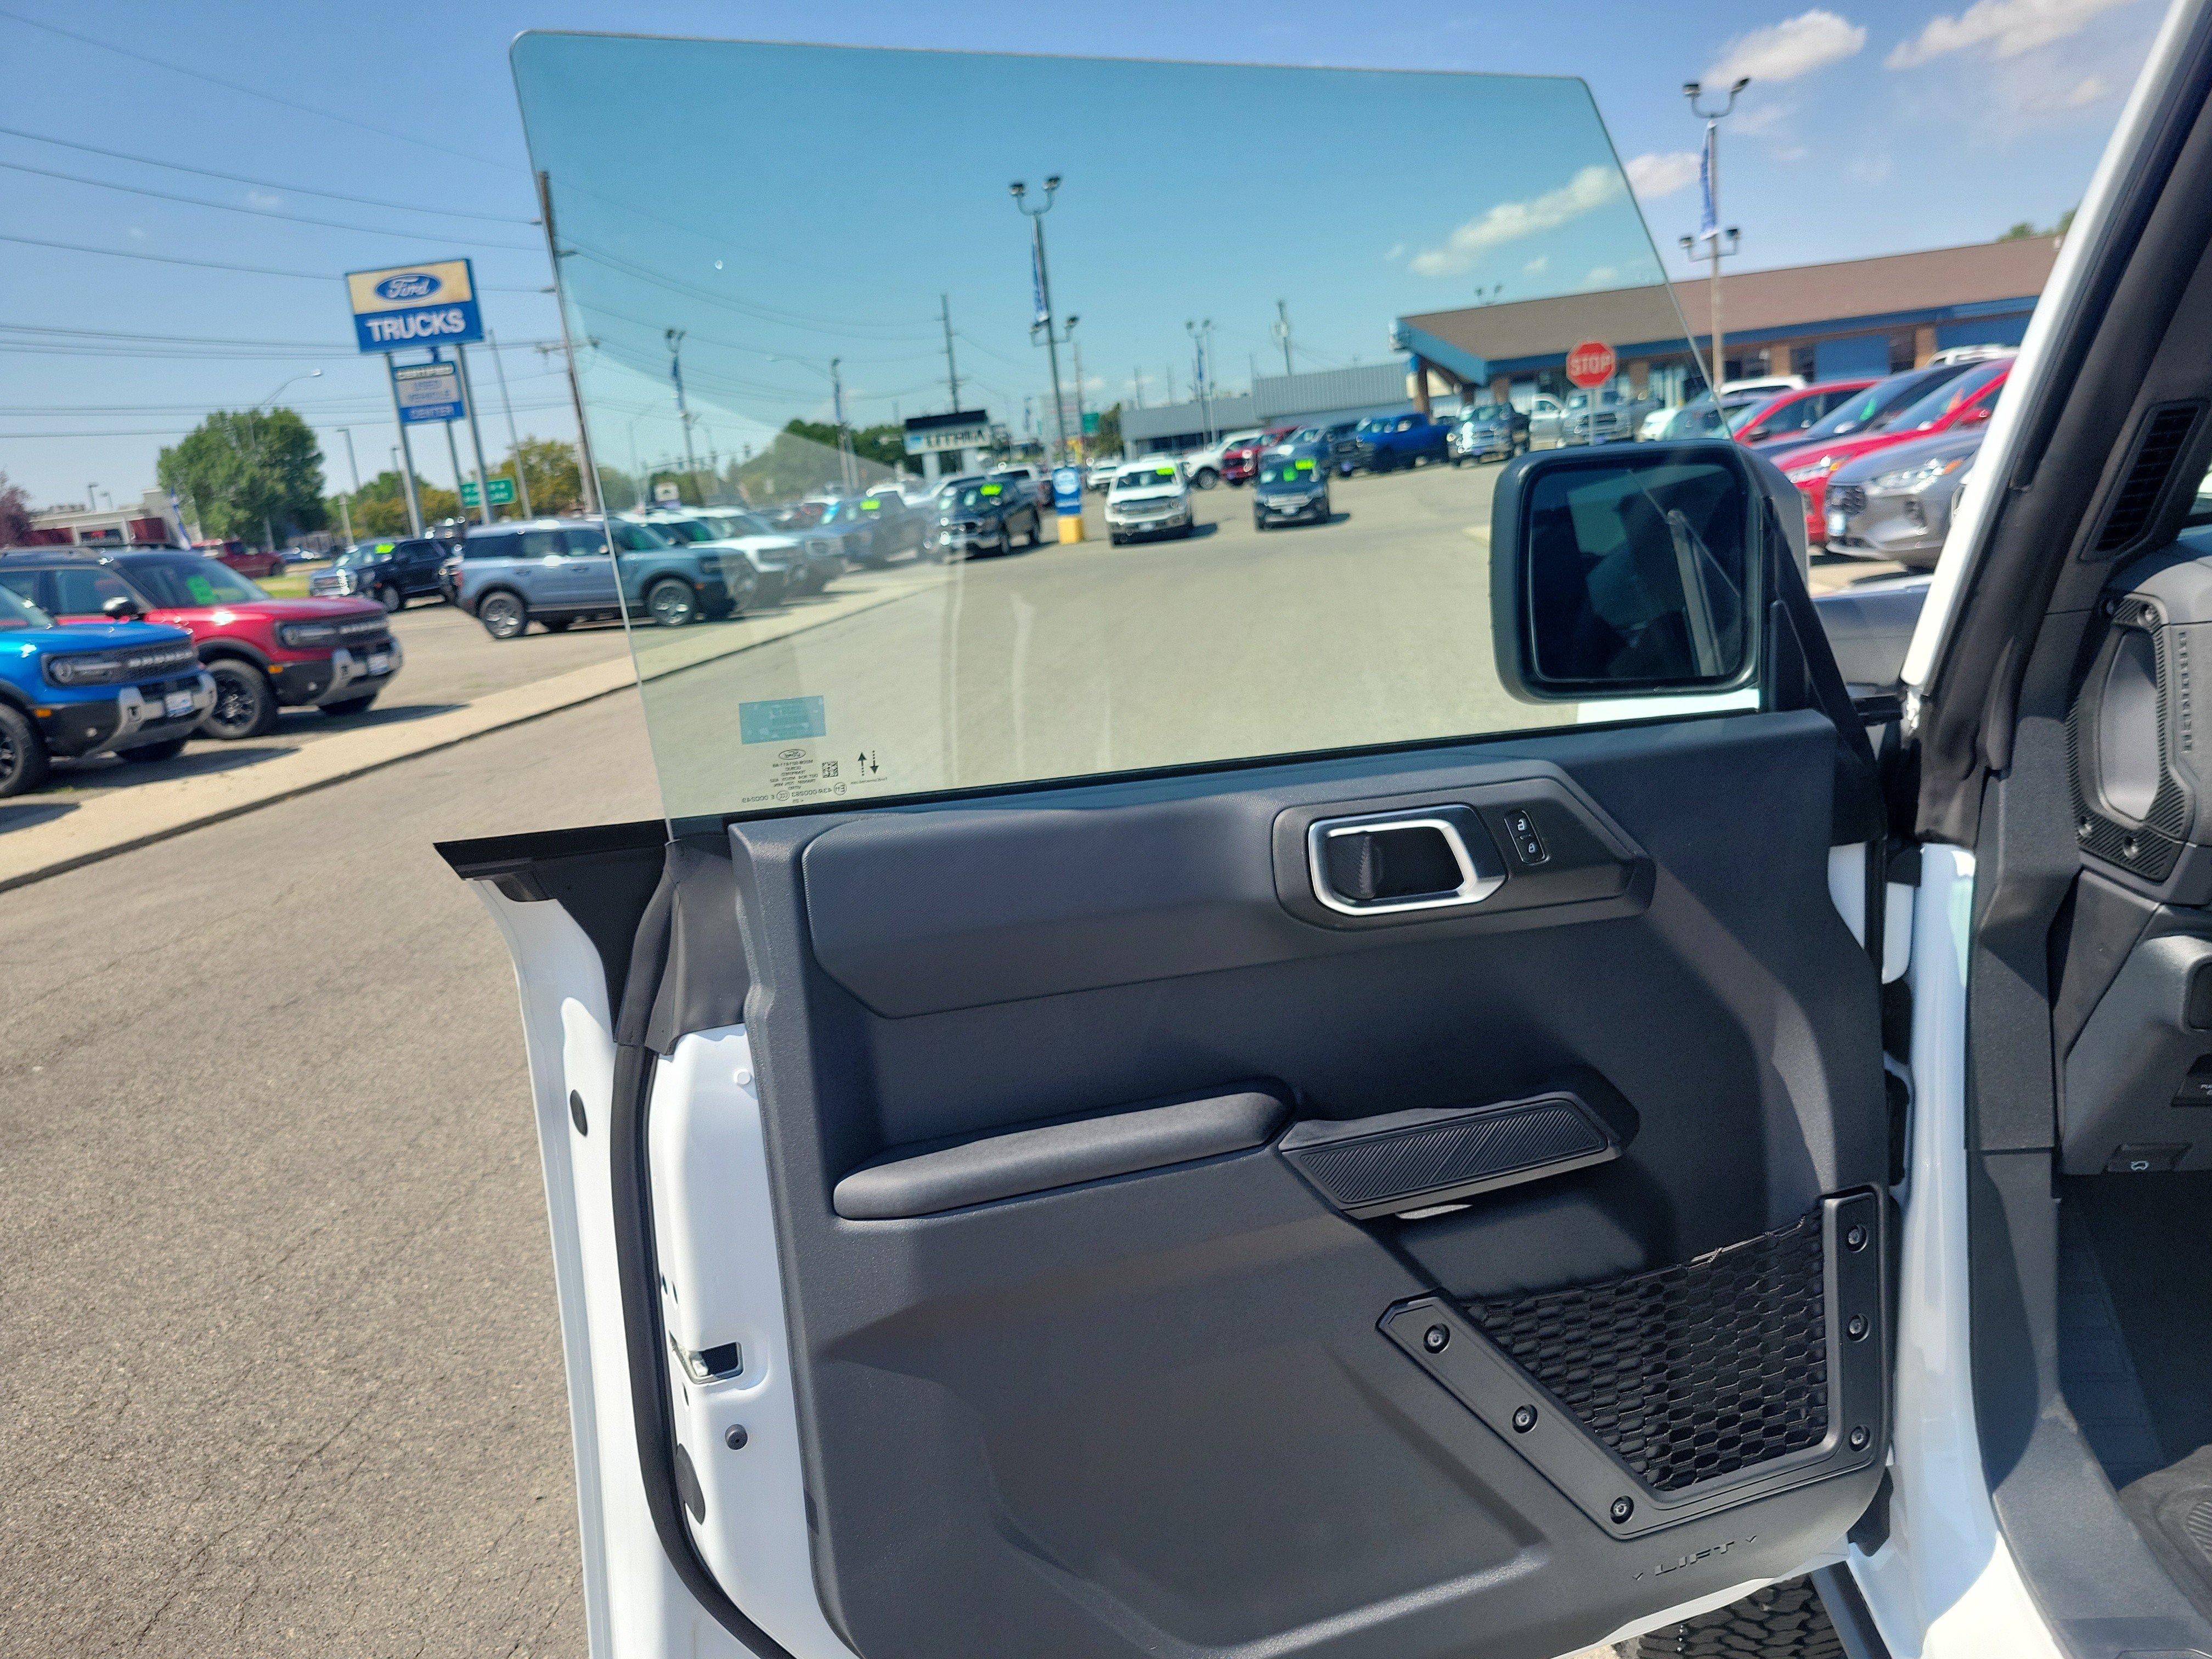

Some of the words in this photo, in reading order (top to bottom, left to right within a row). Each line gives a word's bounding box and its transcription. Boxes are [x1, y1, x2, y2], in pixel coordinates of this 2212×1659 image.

[387, 276, 430, 298] Ford
[366, 308, 466, 342] TRUCKS
[1571, 353, 1611, 376] STOP
[1654, 1541, 1735, 1576] LIFT
